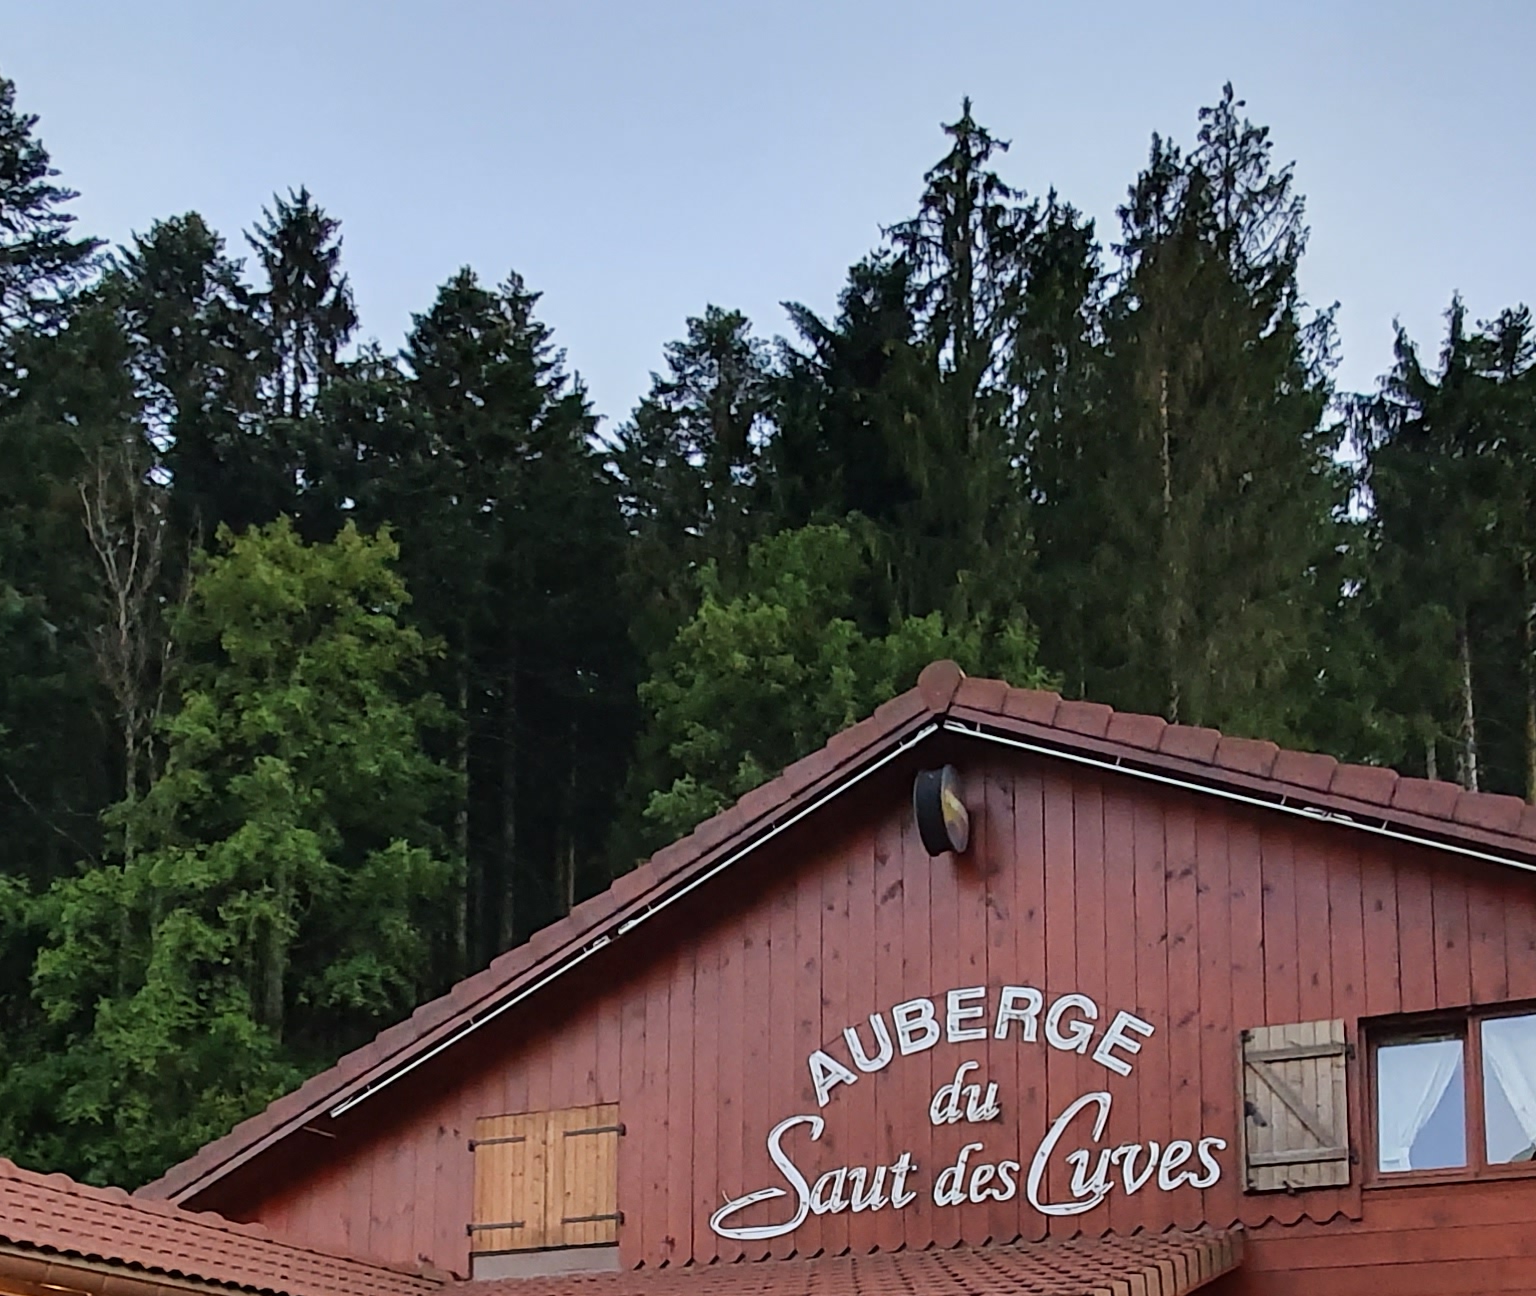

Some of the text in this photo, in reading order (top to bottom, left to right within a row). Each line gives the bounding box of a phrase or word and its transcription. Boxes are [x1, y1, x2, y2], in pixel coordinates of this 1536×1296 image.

[807, 985, 1156, 1107] AUBERGE
[929, 1060, 1000, 1126] du
[710, 1091, 1227, 1240] Saut des Cuves
